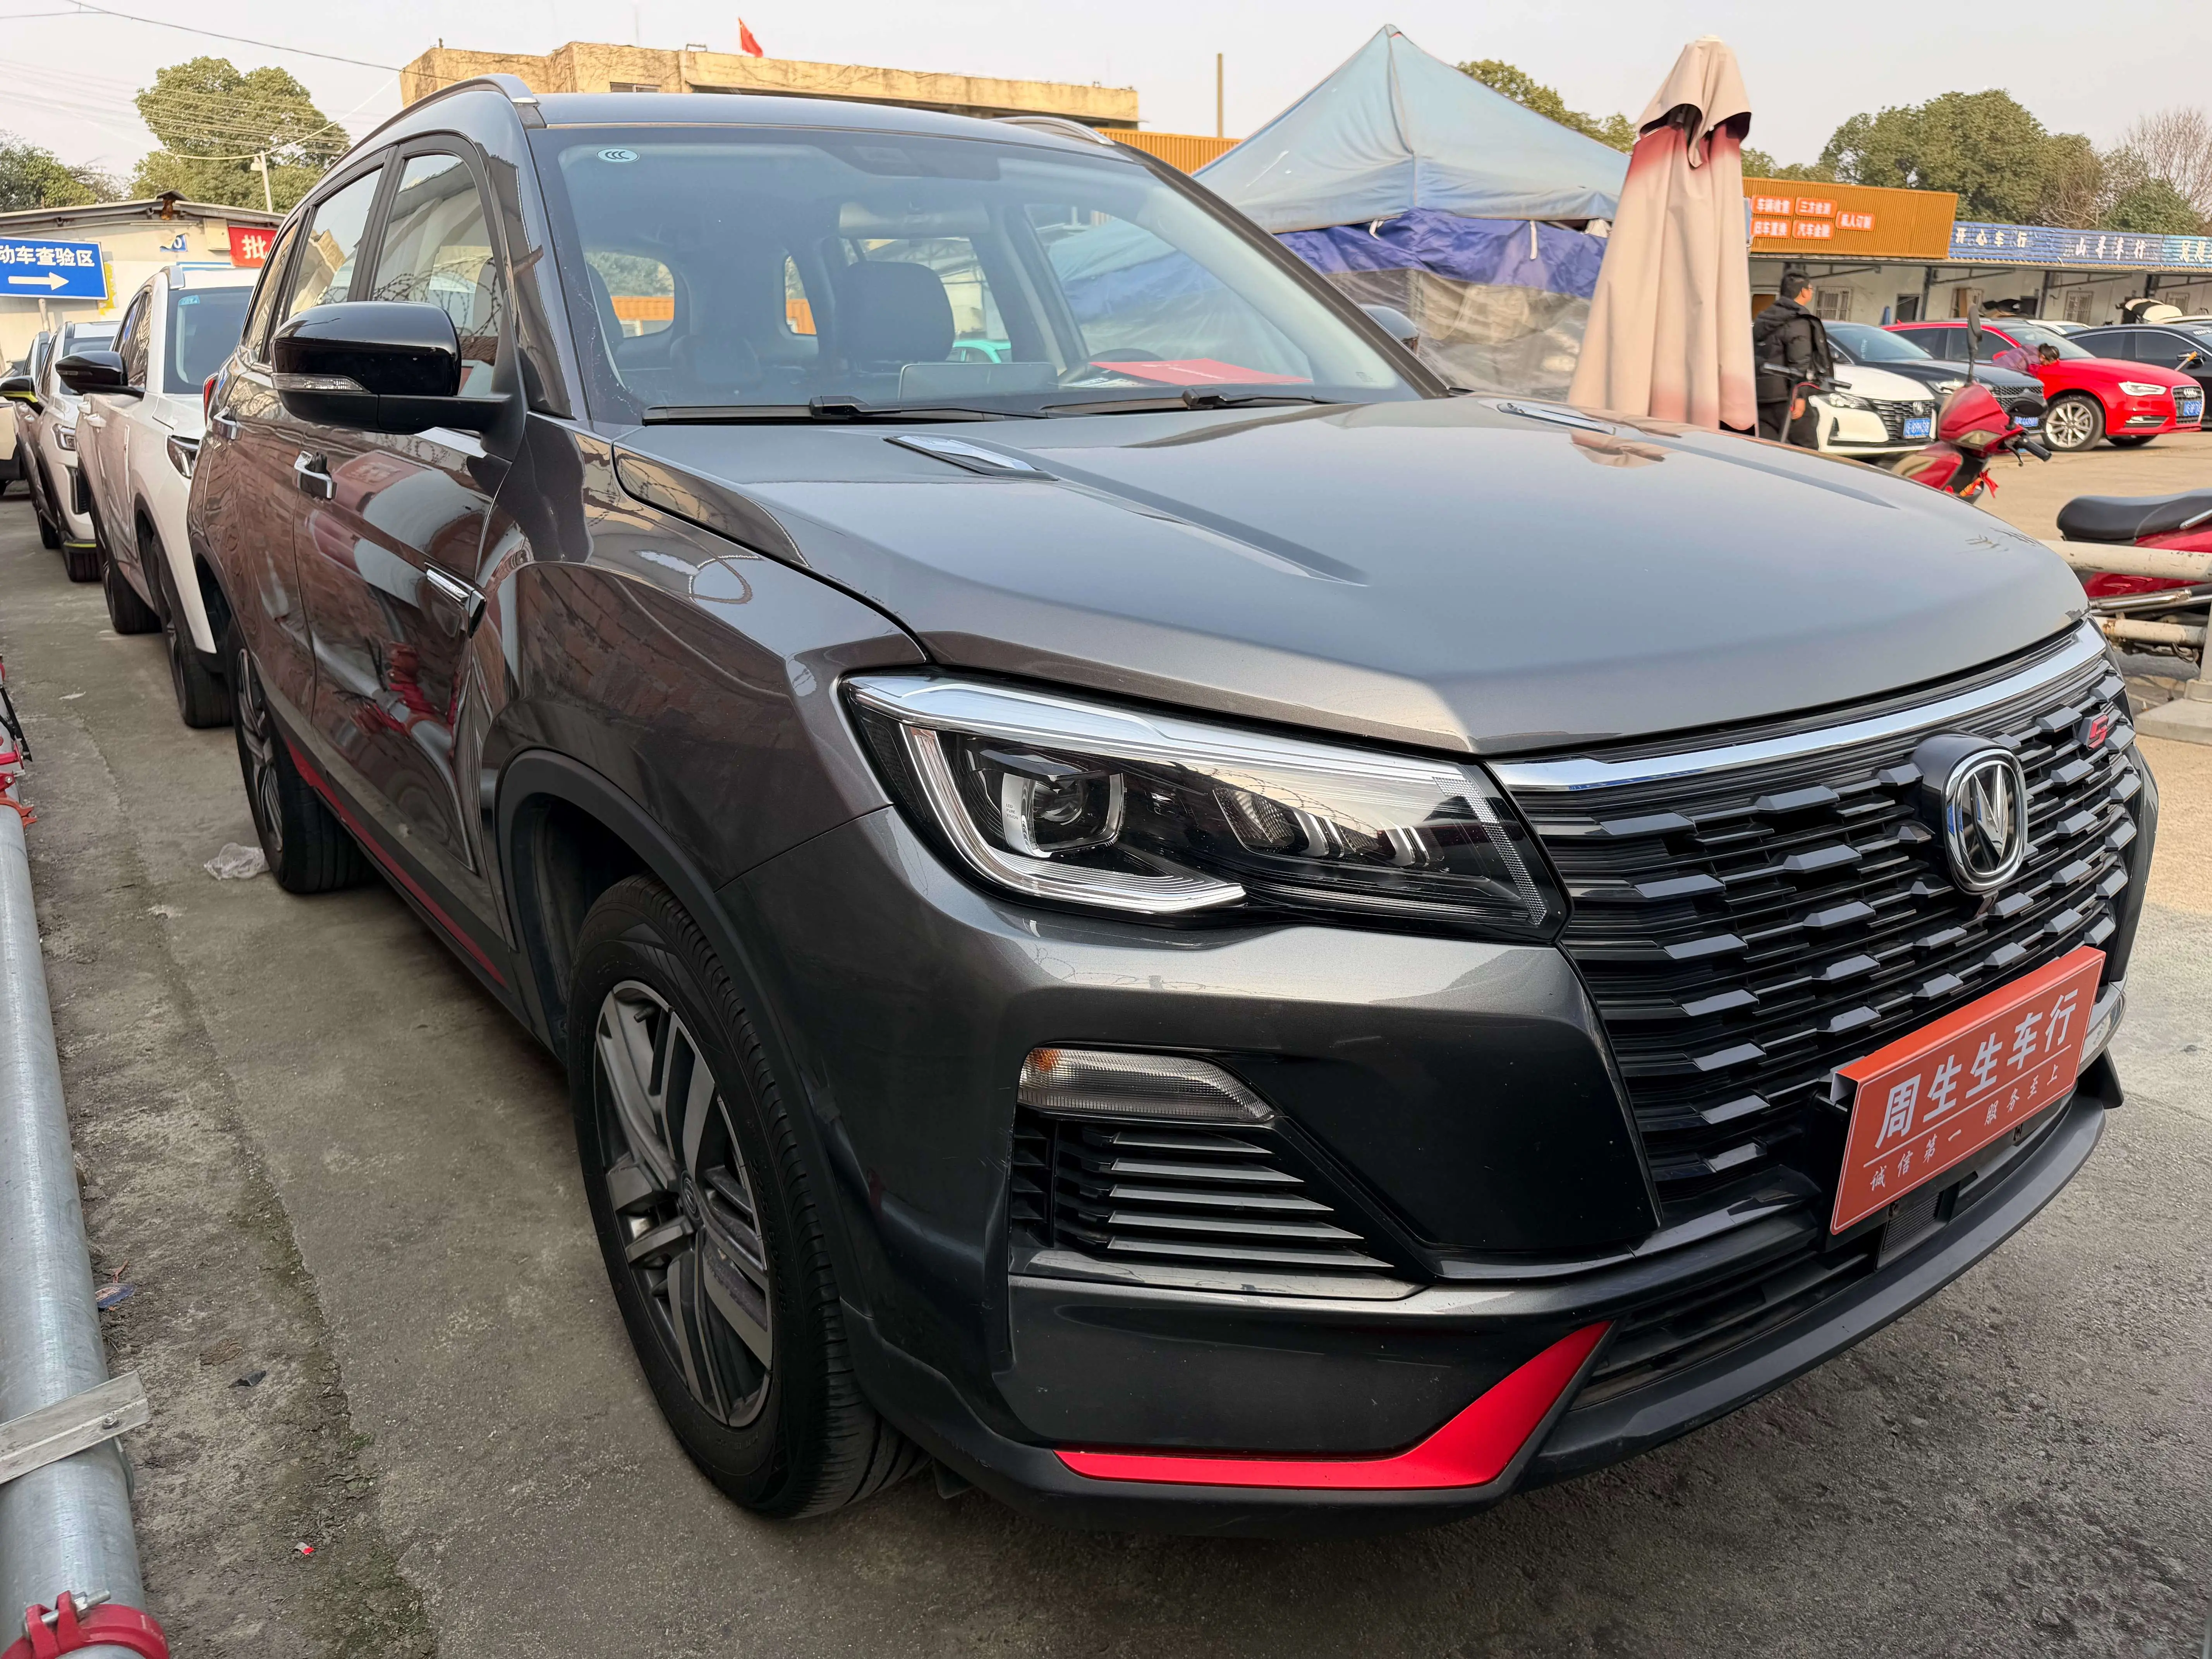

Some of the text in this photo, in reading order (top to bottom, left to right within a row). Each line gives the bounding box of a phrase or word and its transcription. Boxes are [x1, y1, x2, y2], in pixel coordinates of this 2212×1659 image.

[0, 245, 95, 267] 动车查验区
[1956, 227, 2027, 248] 开心车行
[1875, 988, 2078, 1149] 周生生车行
[1870, 1064, 2058, 1191] 诚信第一 服务至上
